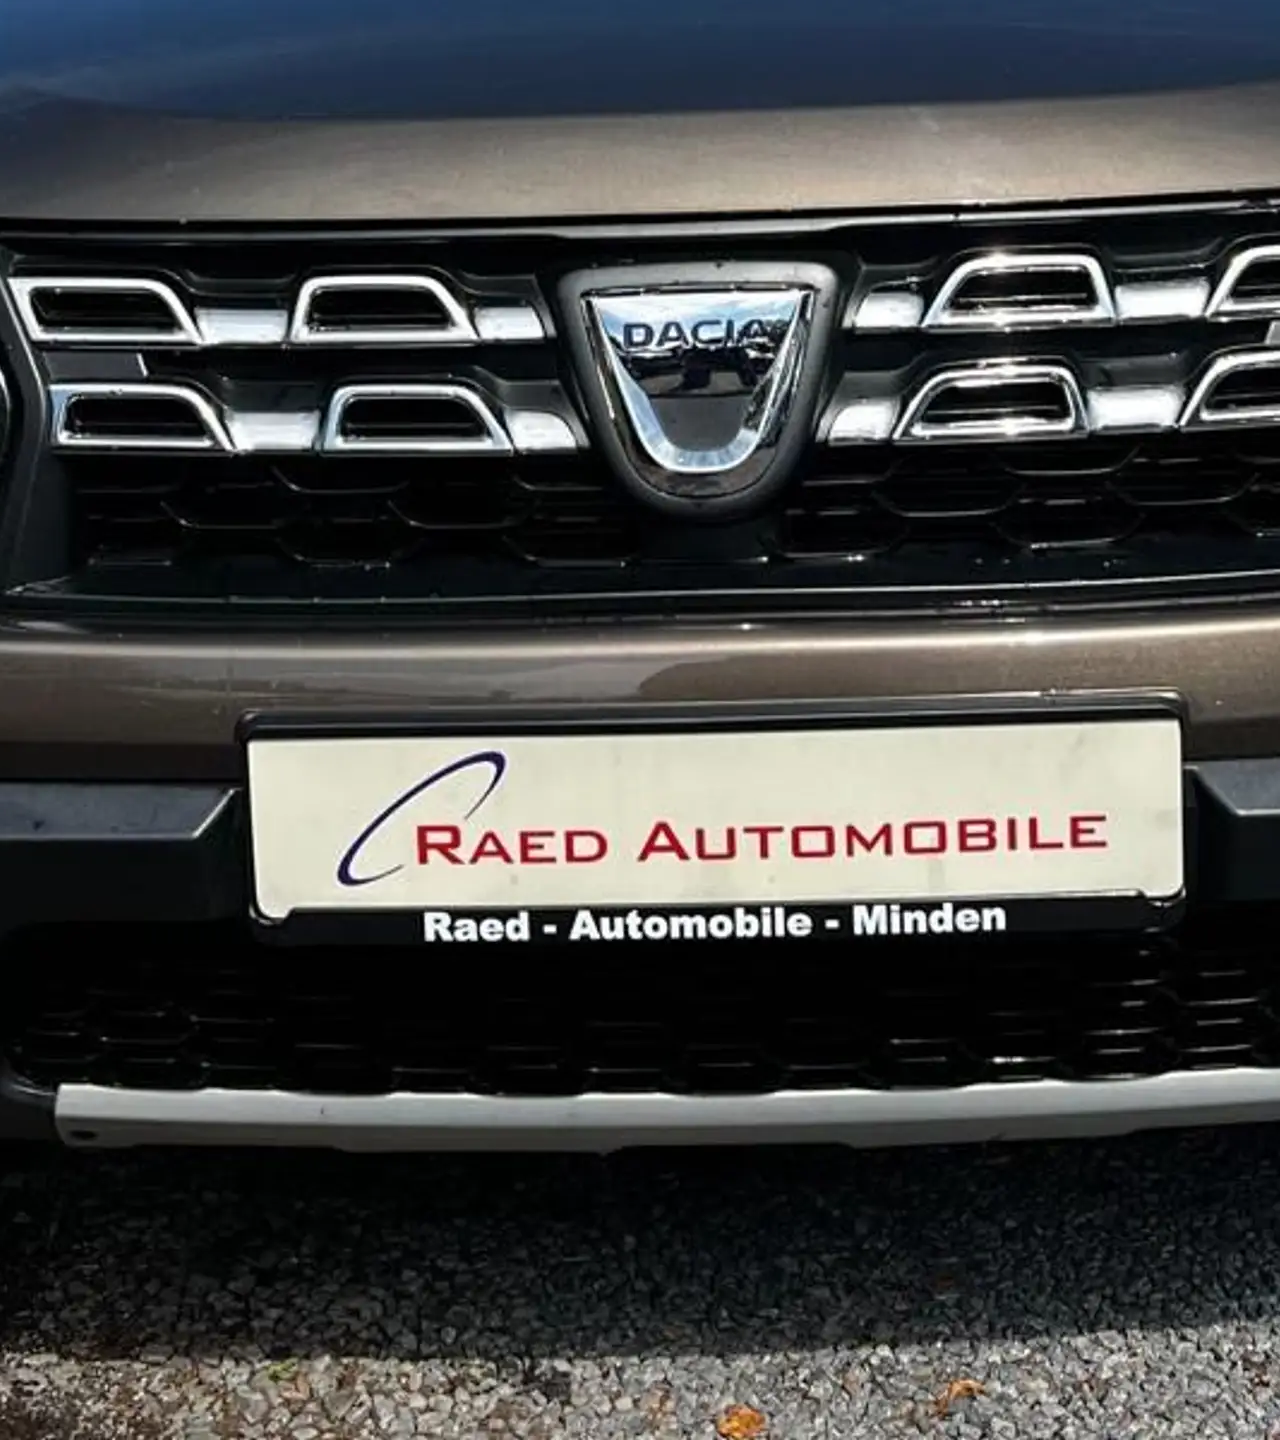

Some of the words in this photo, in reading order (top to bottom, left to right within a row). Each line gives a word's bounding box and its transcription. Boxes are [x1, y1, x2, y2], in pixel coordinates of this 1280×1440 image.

[622, 318, 770, 348] DACIA
[417, 824, 608, 864] RAED
[638, 815, 1107, 862] AUTOMOBILE
[423, 911, 531, 942] Raed
[569, 905, 812, 940] Automobile
[853, 903, 1007, 936] Minden
